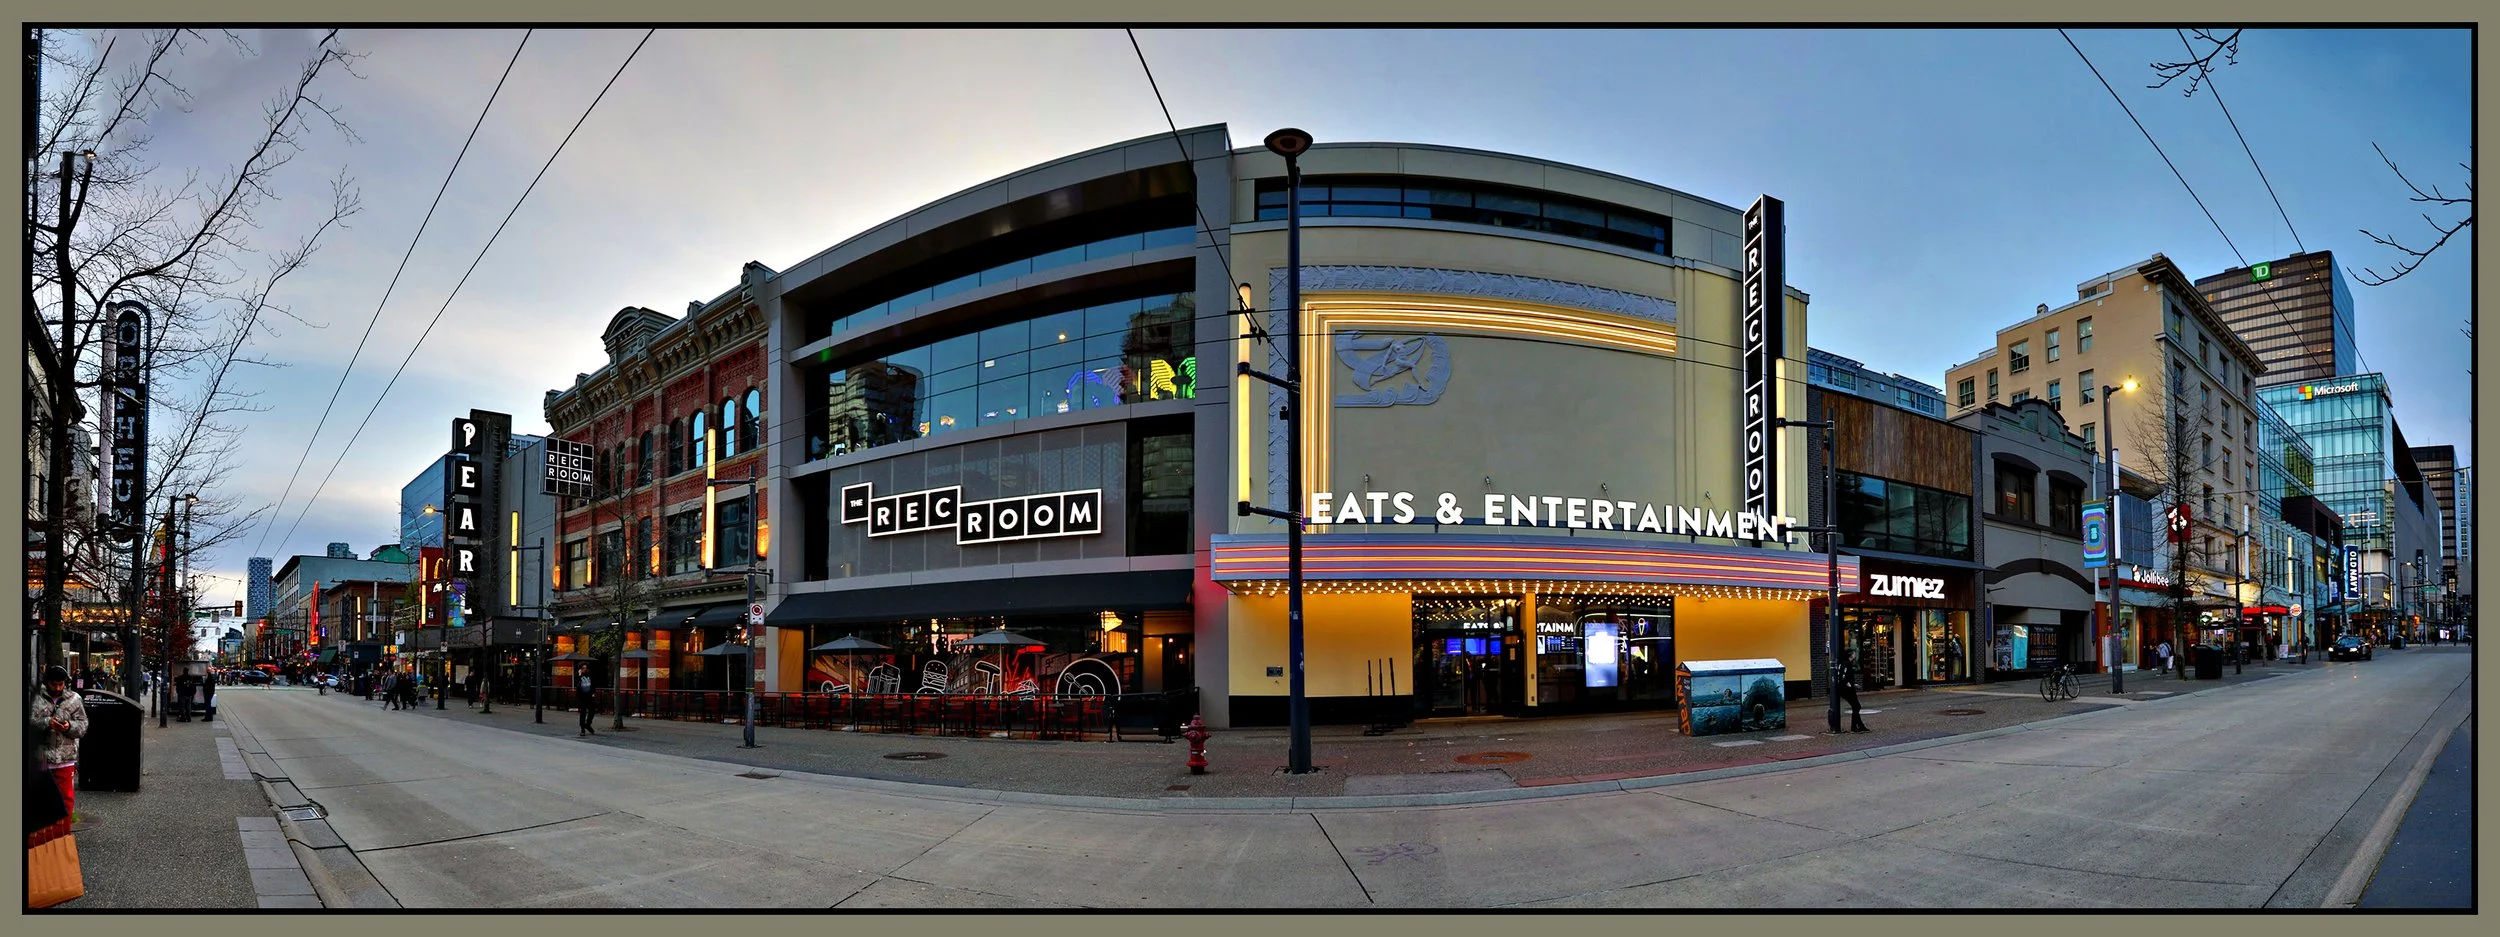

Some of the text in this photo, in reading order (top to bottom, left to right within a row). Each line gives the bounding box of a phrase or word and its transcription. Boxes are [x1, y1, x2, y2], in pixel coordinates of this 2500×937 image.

[2253, 266, 2269, 278] TD
[1748, 247, 1760, 342] REC
[2314, 382, 2358, 396] Microsoft
[548, 454, 579, 467] REC
[1749, 394, 1762, 528] ROOM
[548, 467, 591, 482] ROOM
[850, 498, 1092, 533] THE REC ROOM
[1310, 491, 1797, 543] EATS & ENTERTAINMENT
[2141, 570, 2169, 587] Jollibee
[2349, 551, 2358, 593] OLD NAVY
[1870, 573, 1945, 599] zumiez
